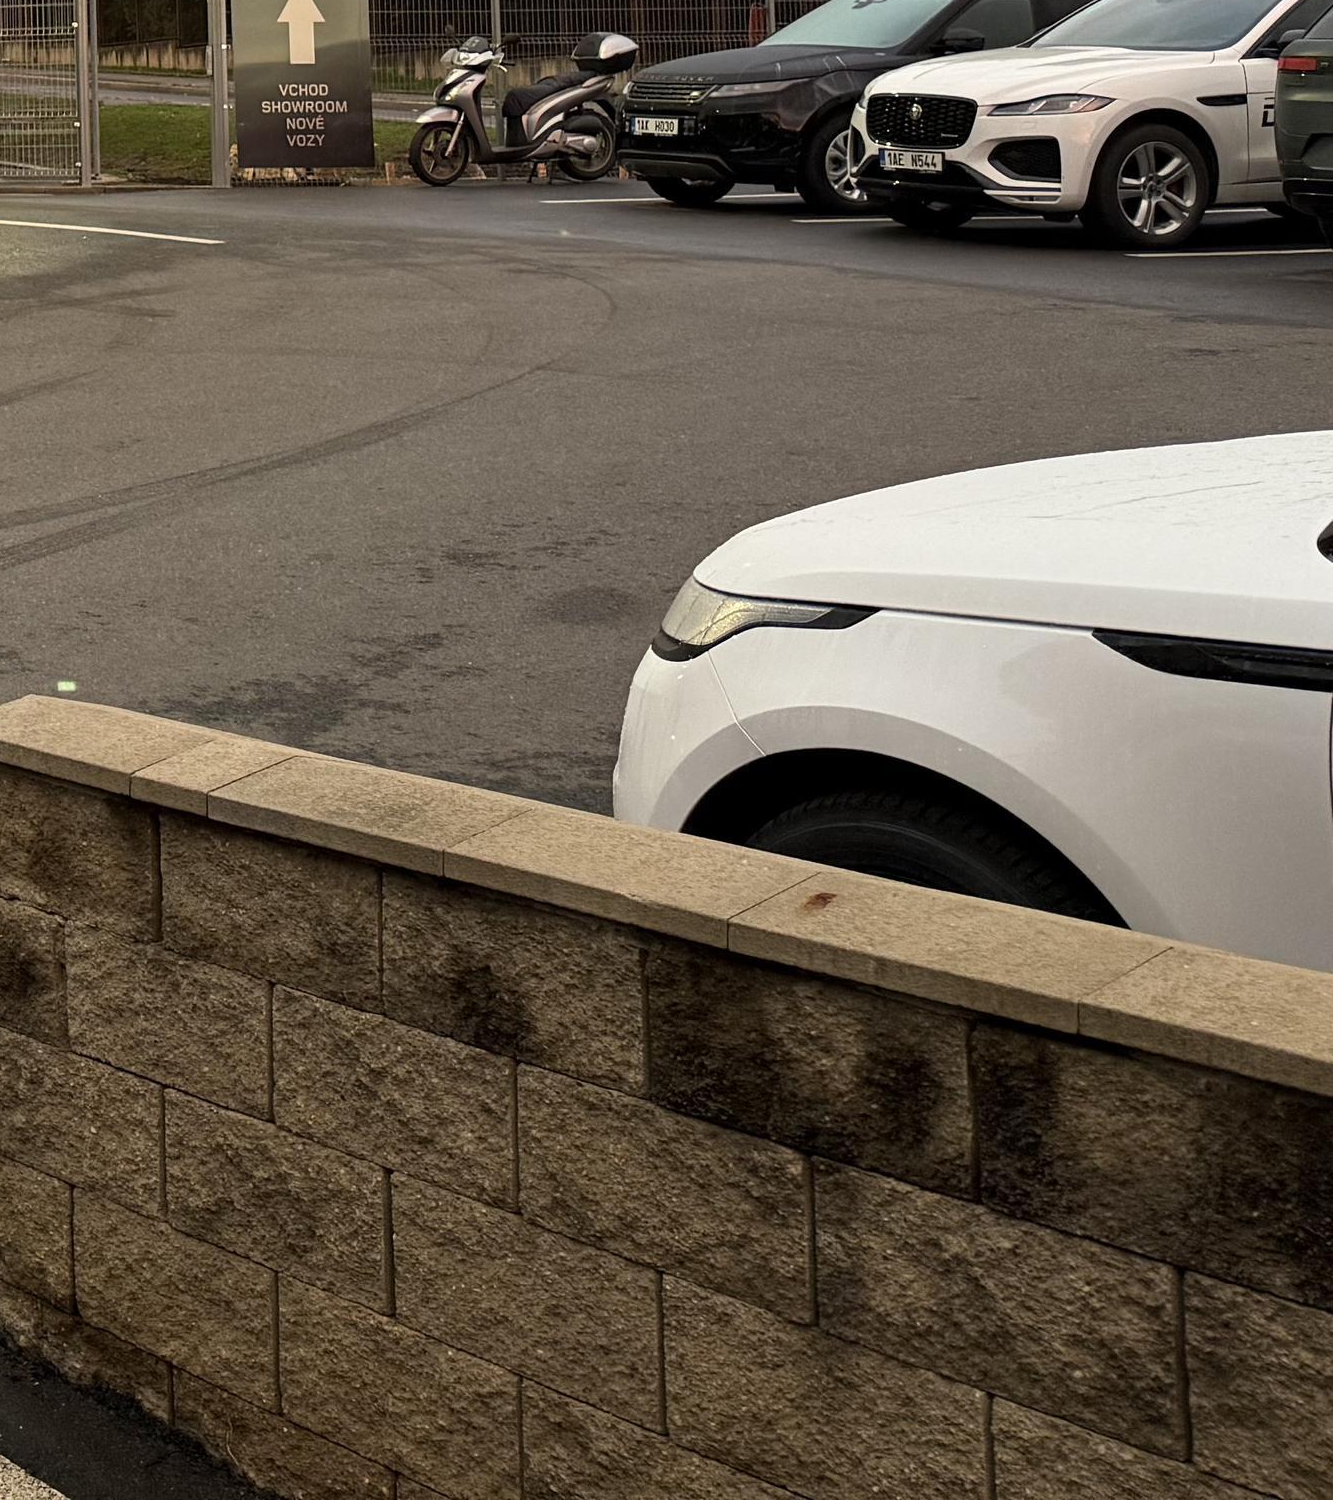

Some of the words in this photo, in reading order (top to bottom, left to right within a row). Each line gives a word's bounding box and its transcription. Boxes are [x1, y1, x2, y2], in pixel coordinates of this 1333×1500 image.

[279, 83, 328, 97] VCHOD
[261, 100, 348, 113] SHOWROOM
[286, 115, 325, 130] NOVÉ
[286, 134, 325, 147] VOZY
[887, 152, 905, 166] 1AE
[911, 154, 937, 168] N544
